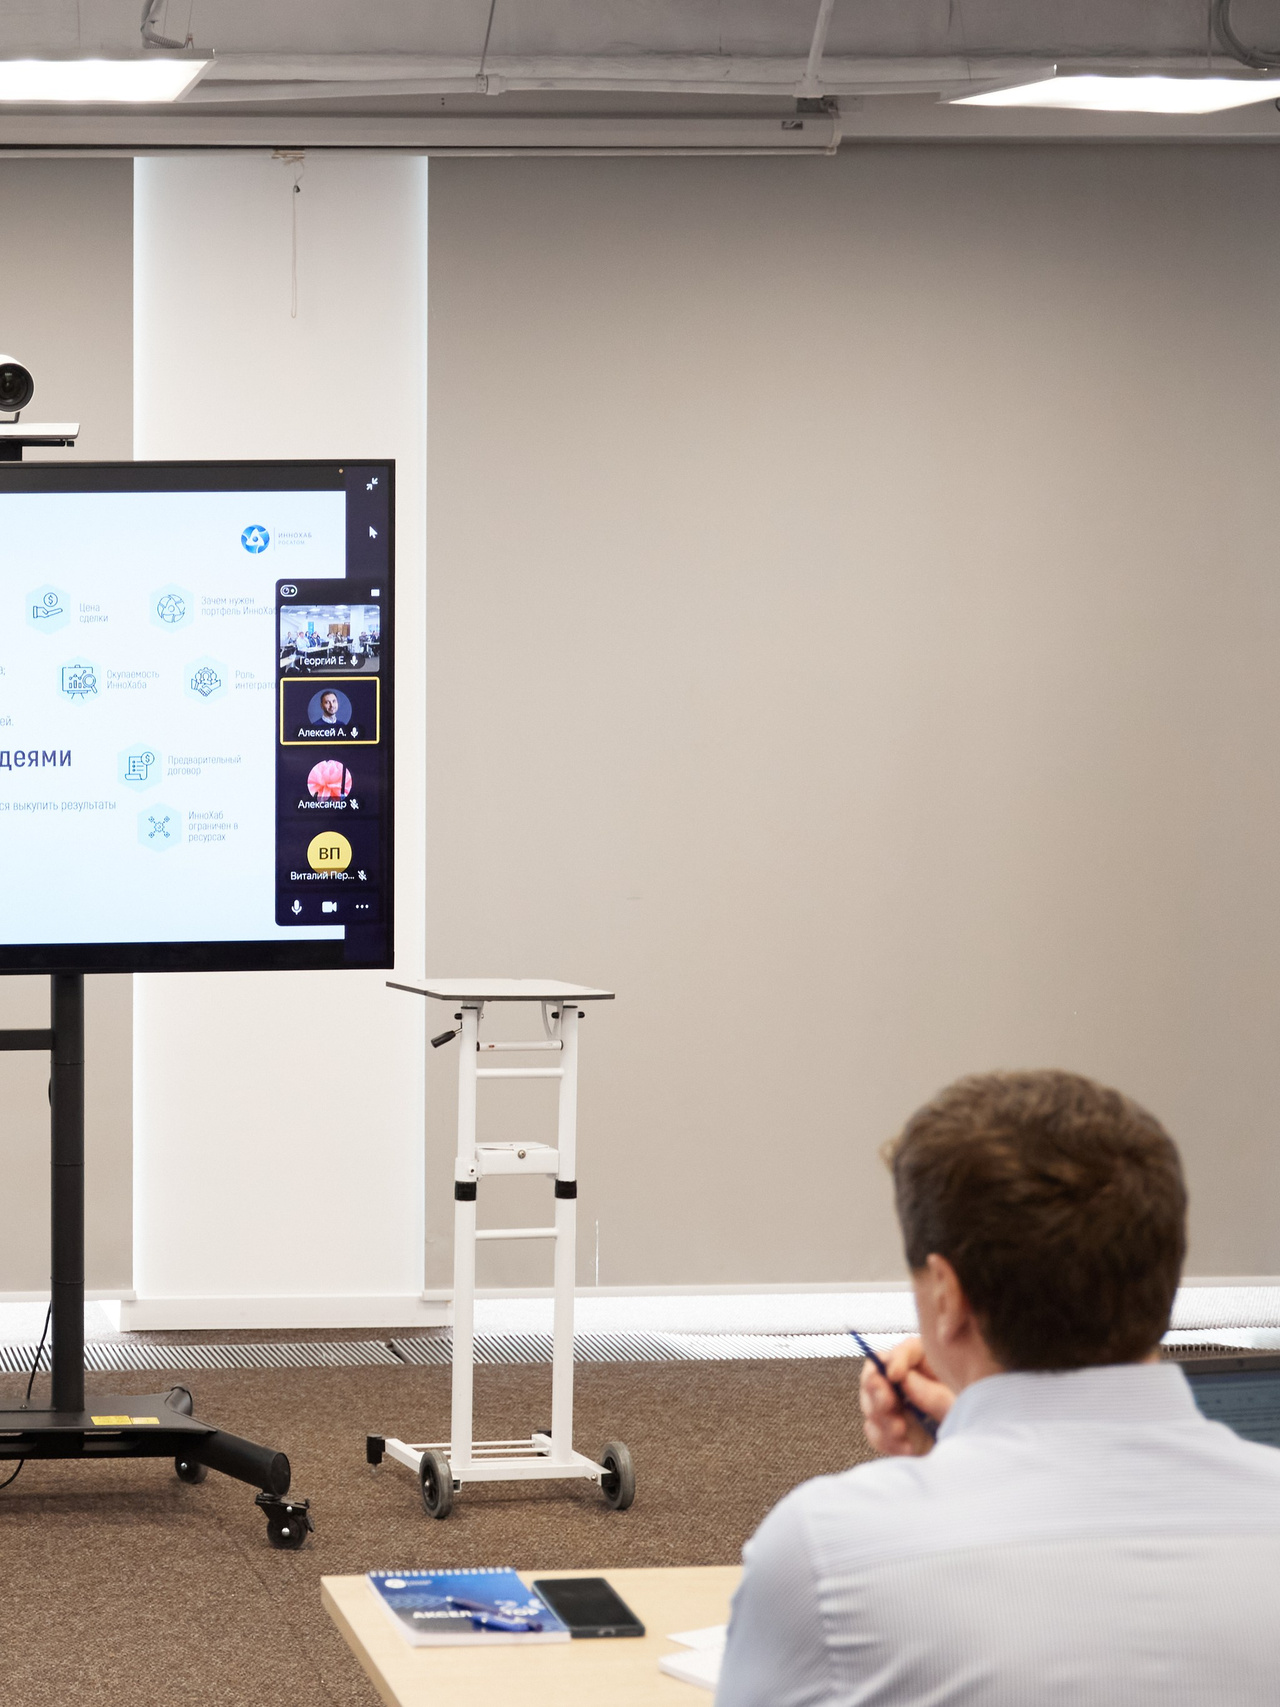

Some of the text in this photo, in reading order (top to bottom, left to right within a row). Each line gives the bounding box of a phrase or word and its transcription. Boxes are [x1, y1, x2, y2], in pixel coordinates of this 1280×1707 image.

[202, 596, 255, 606] Зачем нужен
[80, 603, 100, 613] Цена
[202, 606, 241, 616] портфель
[80, 615, 108, 623] сделки
[300, 656, 346, 666] Георгий Е.
[107, 670, 160, 680] Окупаемость
[235, 670, 255, 679] Роль
[107, 680, 147, 690] ИнноХаба
[298, 728, 346, 737] Алексей А.
[168, 755, 241, 766] Предварительный
[167, 768, 201, 776] договор
[13, 801, 58, 812] выкупить
[61, 800, 116, 811] результаты
[298, 800, 346, 809] Александр
[189, 811, 223, 820] ИнноХаб
[189, 823, 231, 831] ограничен
[189, 834, 225, 843] ресурсах
[319, 848, 340, 859] ВП
[291, 872, 328, 880] Виталий
